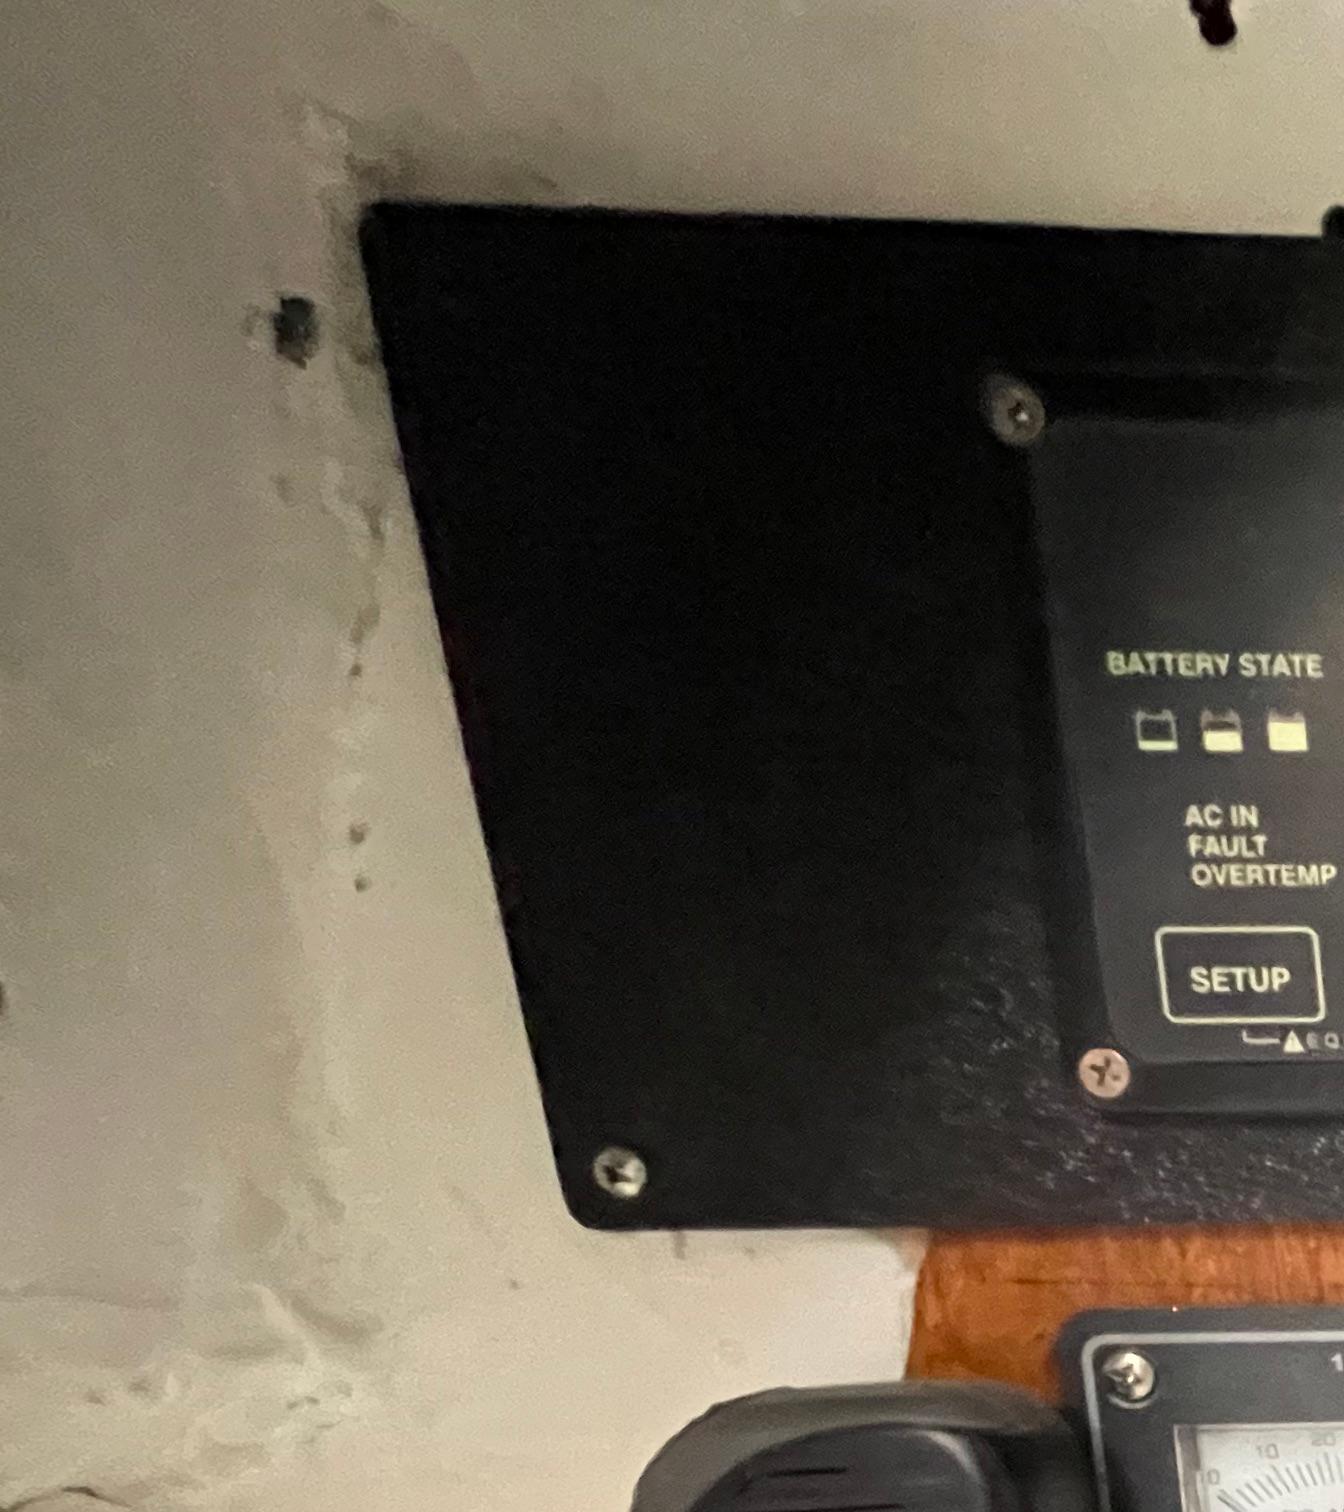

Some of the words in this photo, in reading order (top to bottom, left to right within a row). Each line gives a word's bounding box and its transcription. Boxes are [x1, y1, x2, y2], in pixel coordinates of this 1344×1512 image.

[1108, 652, 1230, 676] BATTERY
[1239, 653, 1323, 678] STATE
[1185, 804, 1222, 828] AC
[1231, 805, 1258, 827] IN
[1189, 834, 1267, 858] FAULT
[1192, 864, 1337, 886] OVERTEMP
[1191, 967, 1290, 993] SETUP
[1256, 1444, 1279, 1459] 10
